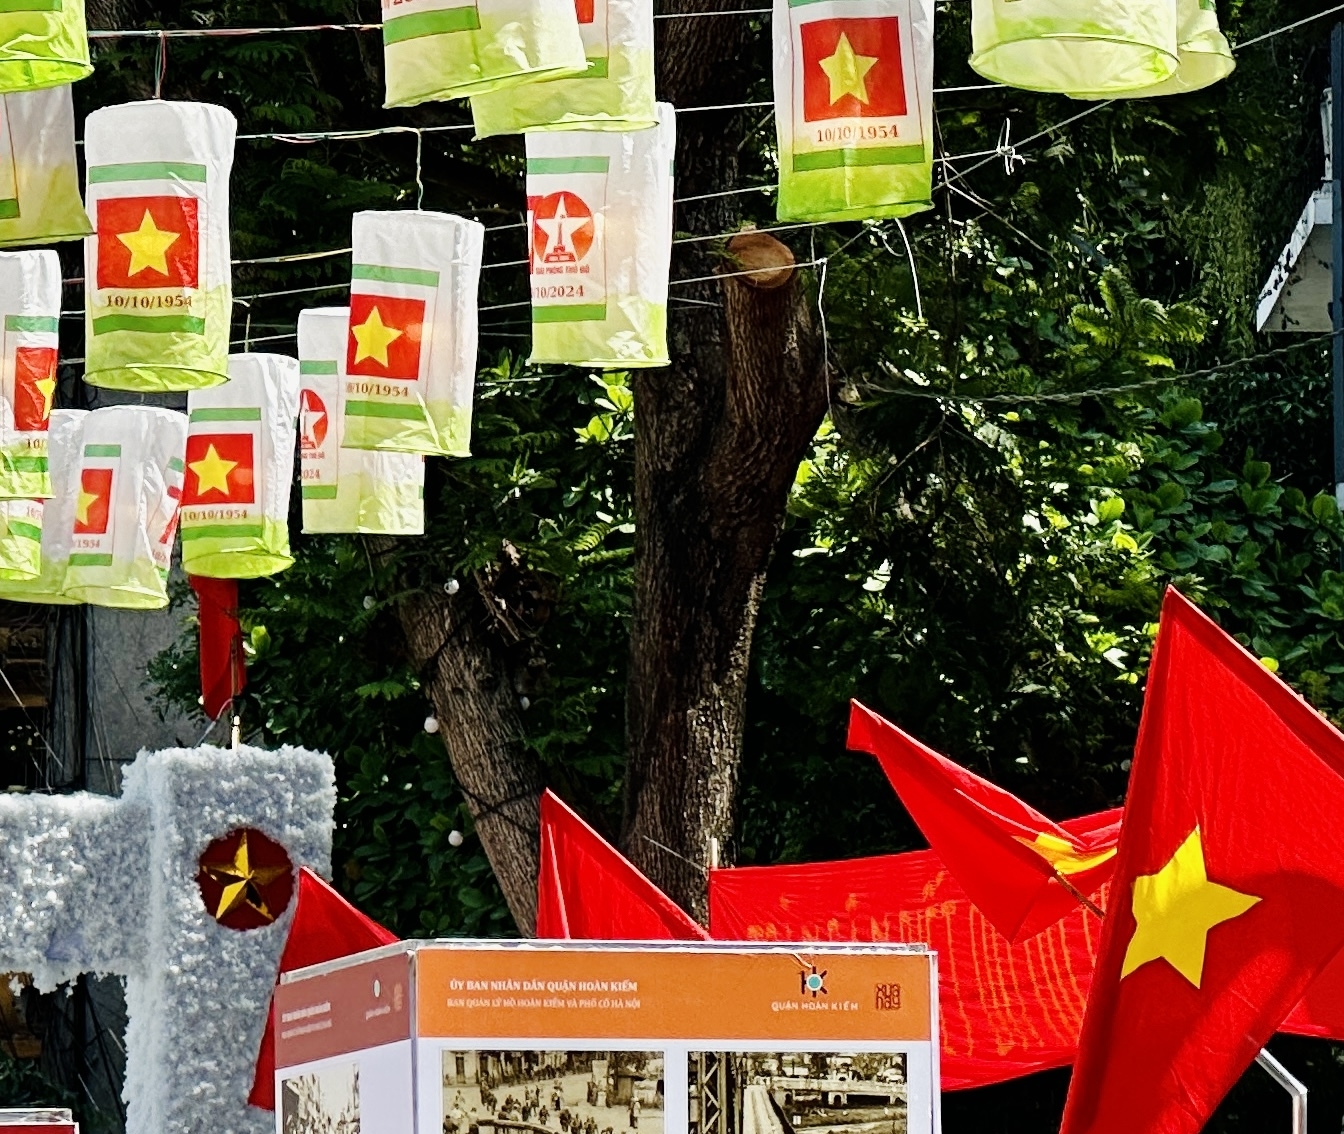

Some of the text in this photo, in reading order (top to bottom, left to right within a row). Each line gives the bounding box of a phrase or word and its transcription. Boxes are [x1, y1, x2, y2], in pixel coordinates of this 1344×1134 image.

[817, 125, 900, 142] 10/10/1954
[105, 293, 193, 310] 10/10/1954
[183, 509, 248, 522] 10/10/1954
[467, 980, 488, 991] BAN
[490, 979, 521, 991] NHÂN
[523, 978, 545, 991] DÂN
[547, 979, 576, 993] QUẬN
[579, 979, 608, 992] HOÀN
[610, 978, 638, 992] KIẾM
